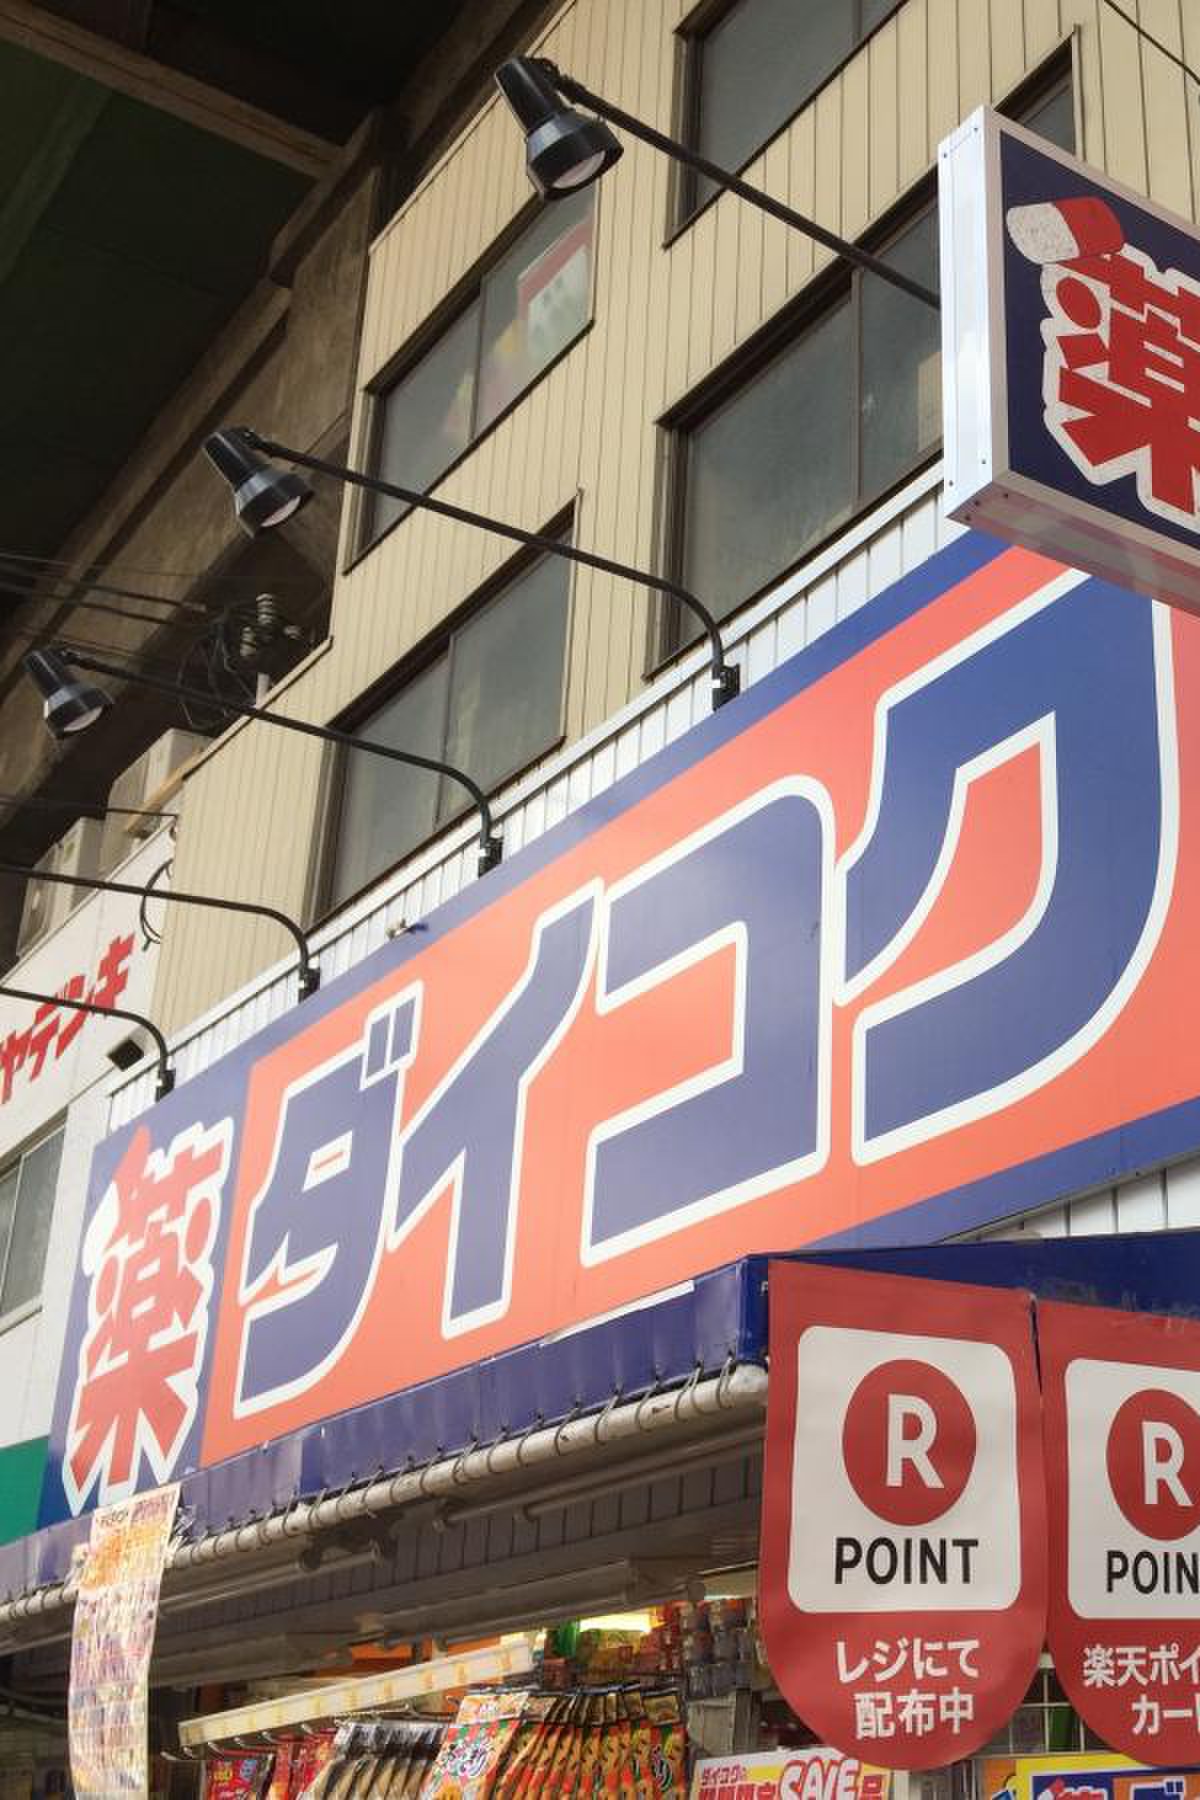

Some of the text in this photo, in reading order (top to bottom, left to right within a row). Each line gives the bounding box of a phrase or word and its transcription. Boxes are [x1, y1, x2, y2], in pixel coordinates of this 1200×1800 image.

[61, 566, 1181, 1519] 薬 ダイコク
[885, 1393, 945, 1489] R
[1140, 1420, 1193, 1508] R
[833, 1536, 980, 1586] POINT
[835, 1637, 981, 1685] レジにて
[853, 1686, 975, 1739] 配布中
